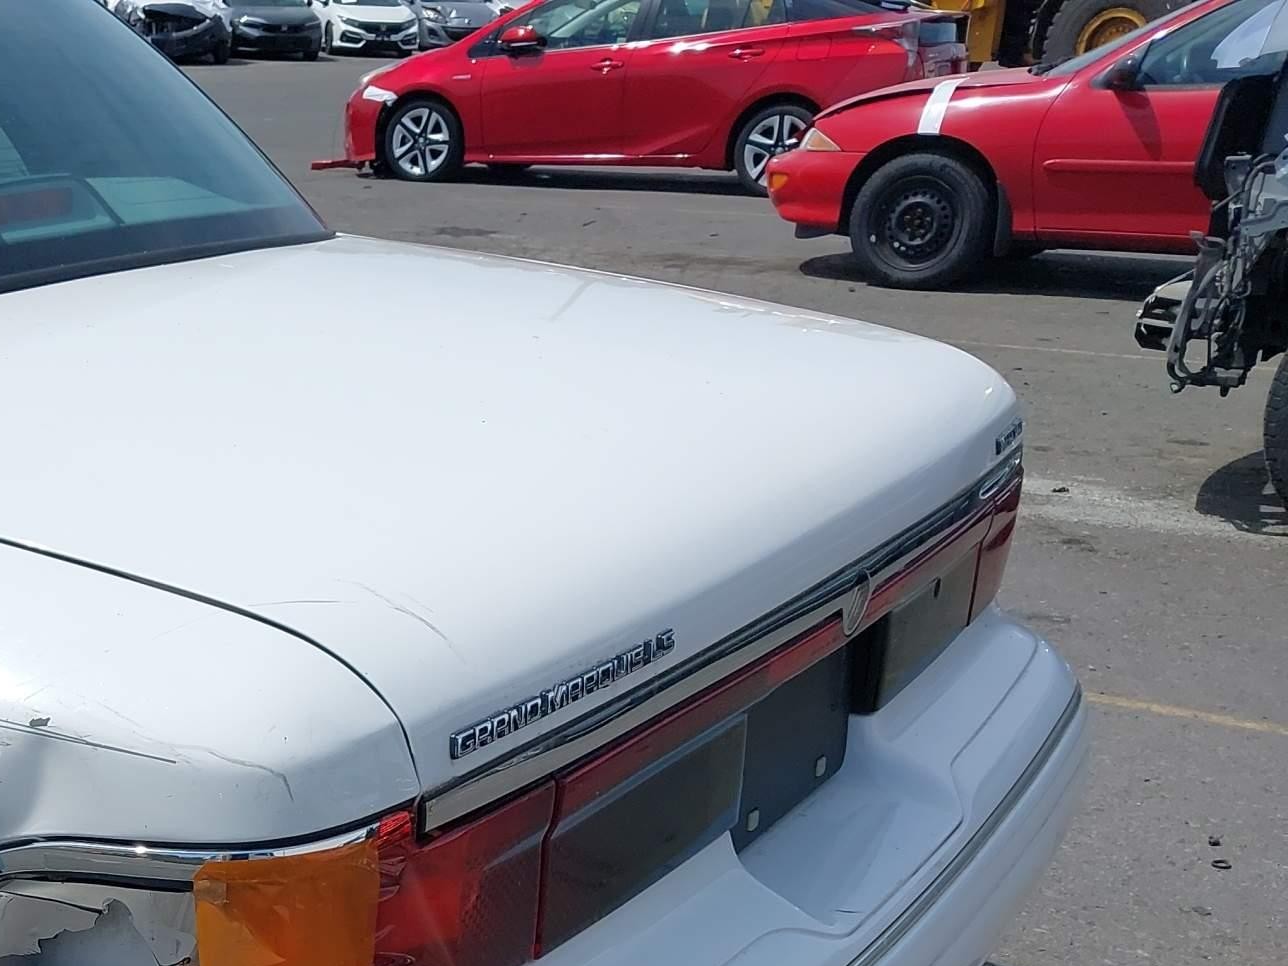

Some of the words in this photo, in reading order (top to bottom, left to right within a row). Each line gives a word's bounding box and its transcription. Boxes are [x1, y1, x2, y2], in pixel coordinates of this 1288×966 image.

[451, 696, 542, 758] GRAND
[544, 645, 646, 713] MARQUIS
[646, 628, 676, 663] LS
